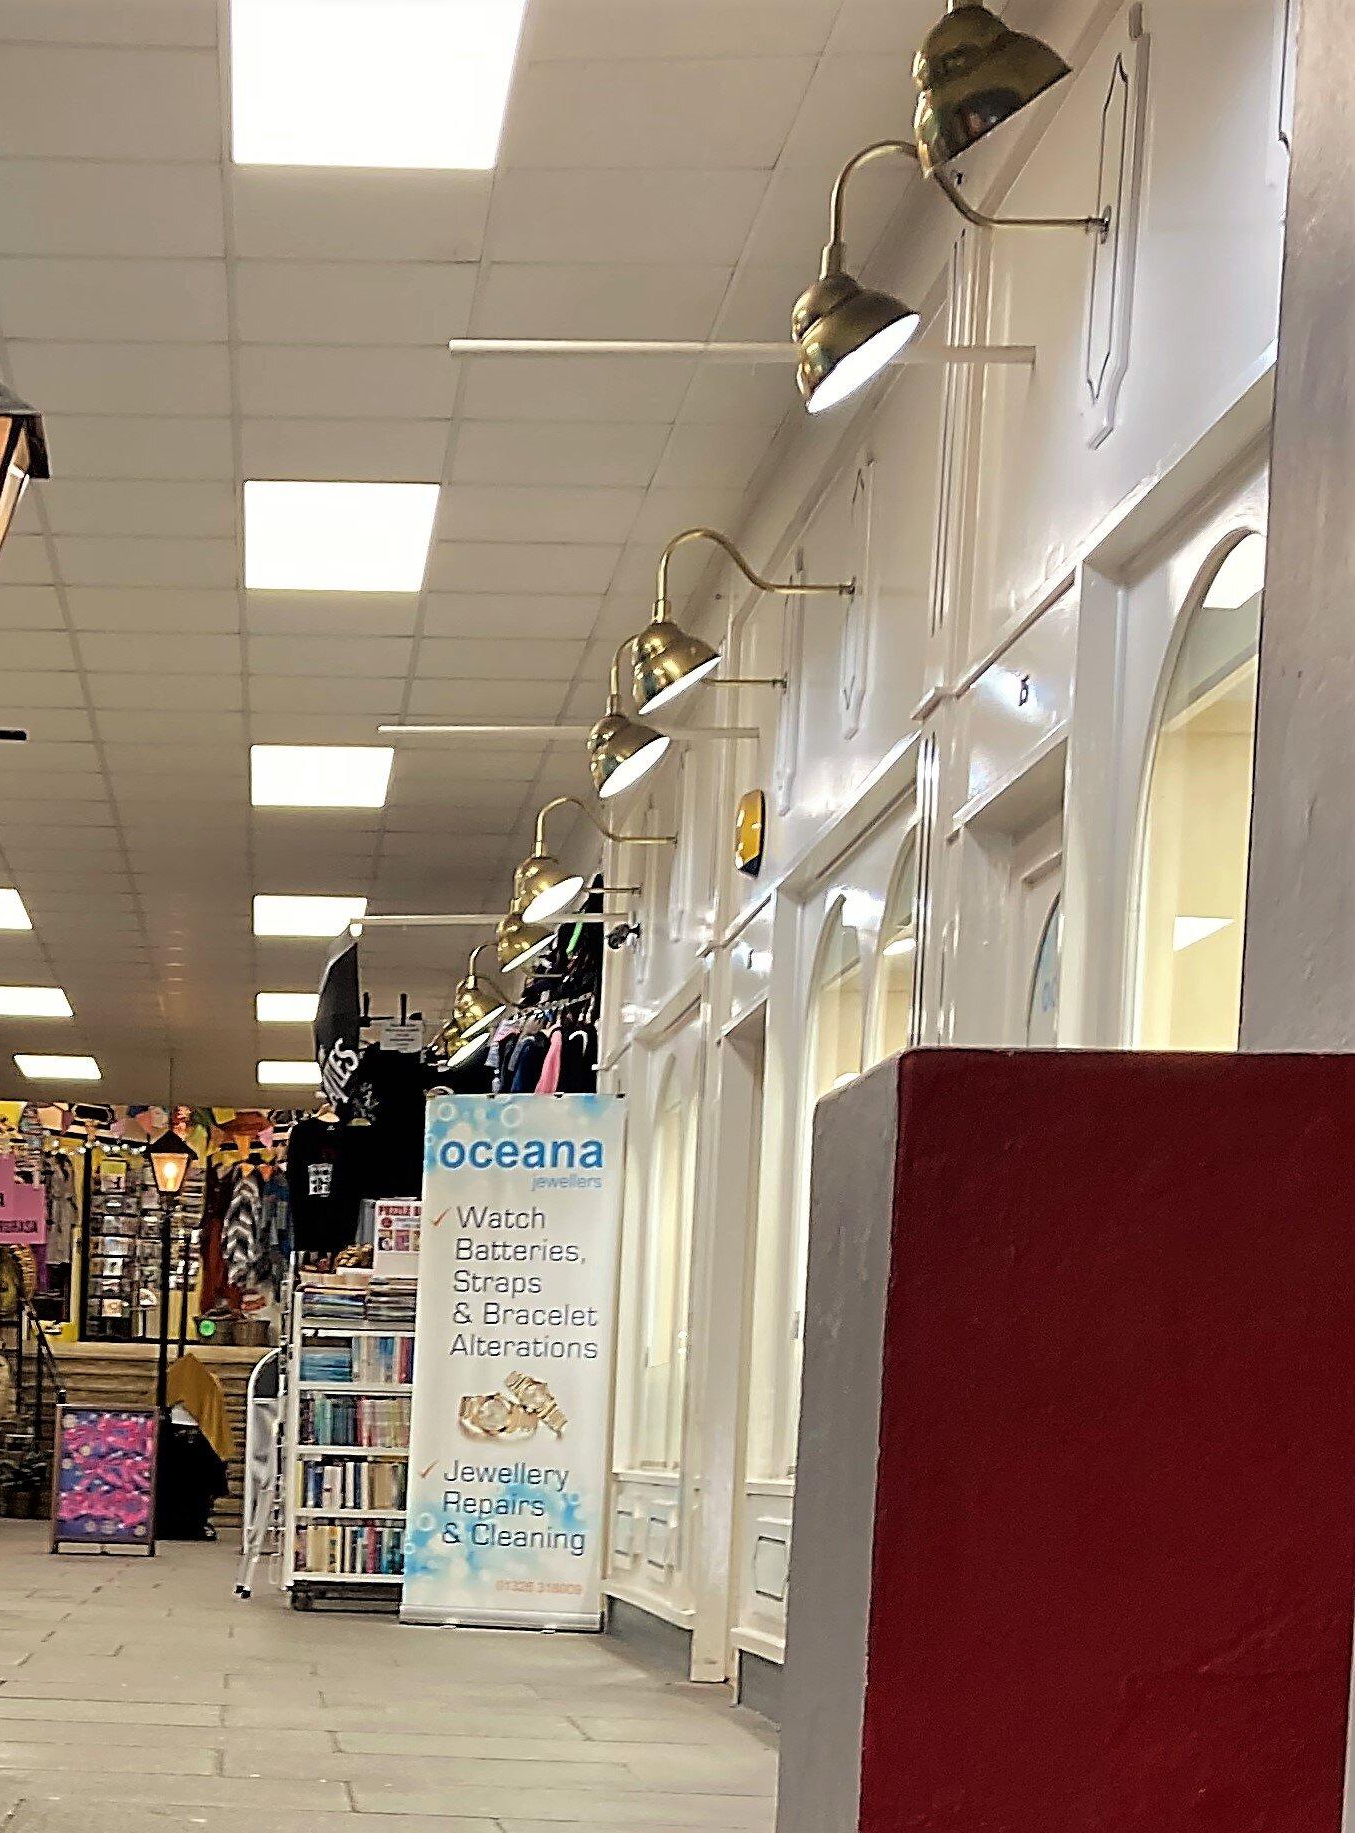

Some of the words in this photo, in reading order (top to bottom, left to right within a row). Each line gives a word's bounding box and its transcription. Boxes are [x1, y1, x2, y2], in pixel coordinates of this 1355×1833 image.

[439, 1139, 603, 1169] oceana
[531, 1174, 602, 1192] jewellers
[457, 1206, 546, 1229] Watch
[456, 1238, 586, 1264] Batteries,
[453, 1269, 543, 1299] Straps
[452, 1302, 472, 1325] &
[483, 1302, 598, 1327] Bracelet
[449, 1333, 598, 1360] Alterations
[444, 1460, 570, 1493] Jewellery
[443, 1490, 546, 1519] Repairs
[443, 1521, 462, 1544] &
[471, 1522, 586, 1557] Cleaning
